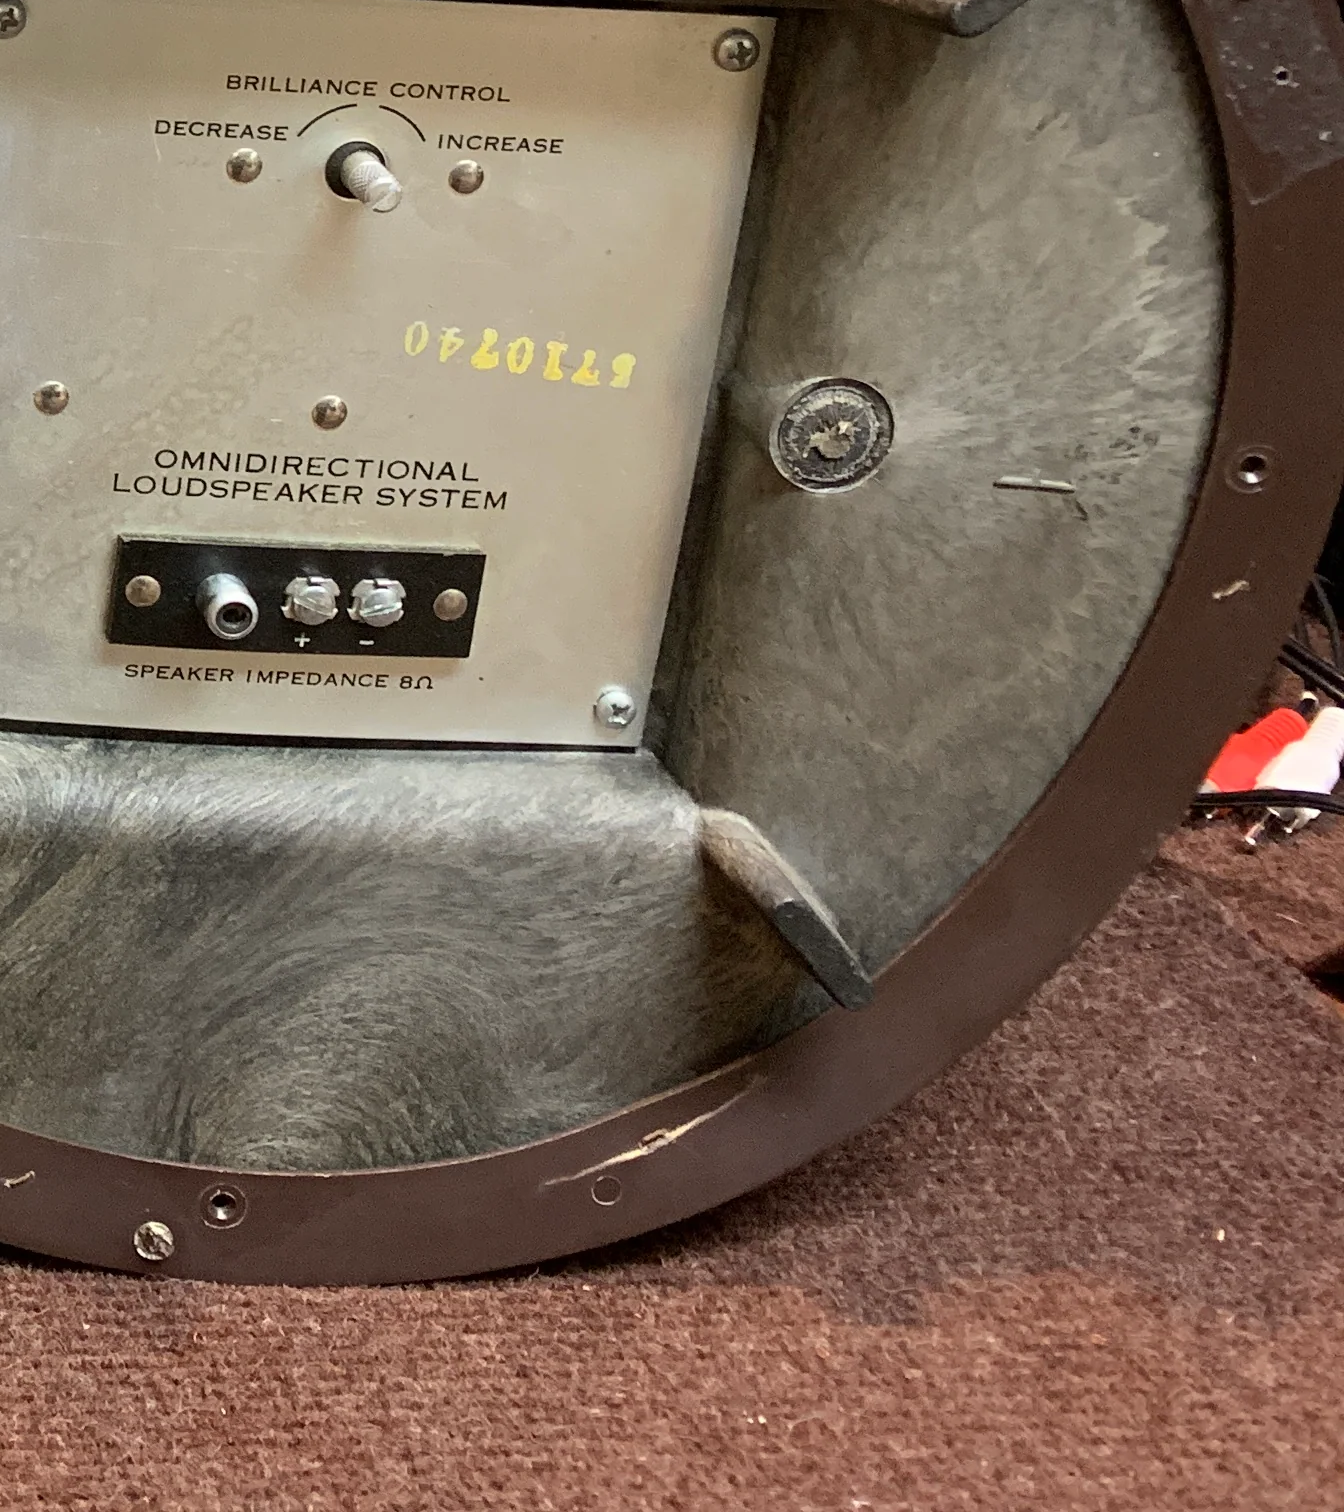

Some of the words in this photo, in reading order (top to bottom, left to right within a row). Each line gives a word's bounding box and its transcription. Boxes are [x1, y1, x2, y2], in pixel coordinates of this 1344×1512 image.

[226, 75, 378, 97] BRILLIANCE
[390, 82, 510, 102] CONTROL
[154, 120, 289, 141] DECREASE
[437, 134, 563, 154] INCREASE
[404, 321, 636, 388] 5710740
[155, 449, 479, 482] OMNIDIRECTIONAL
[113, 473, 362, 505] LOUDSPEAKER
[376, 488, 507, 510] SYSTEM
[125, 664, 233, 682] SPEAKER
[247, 669, 389, 688] IMPEDANCE
